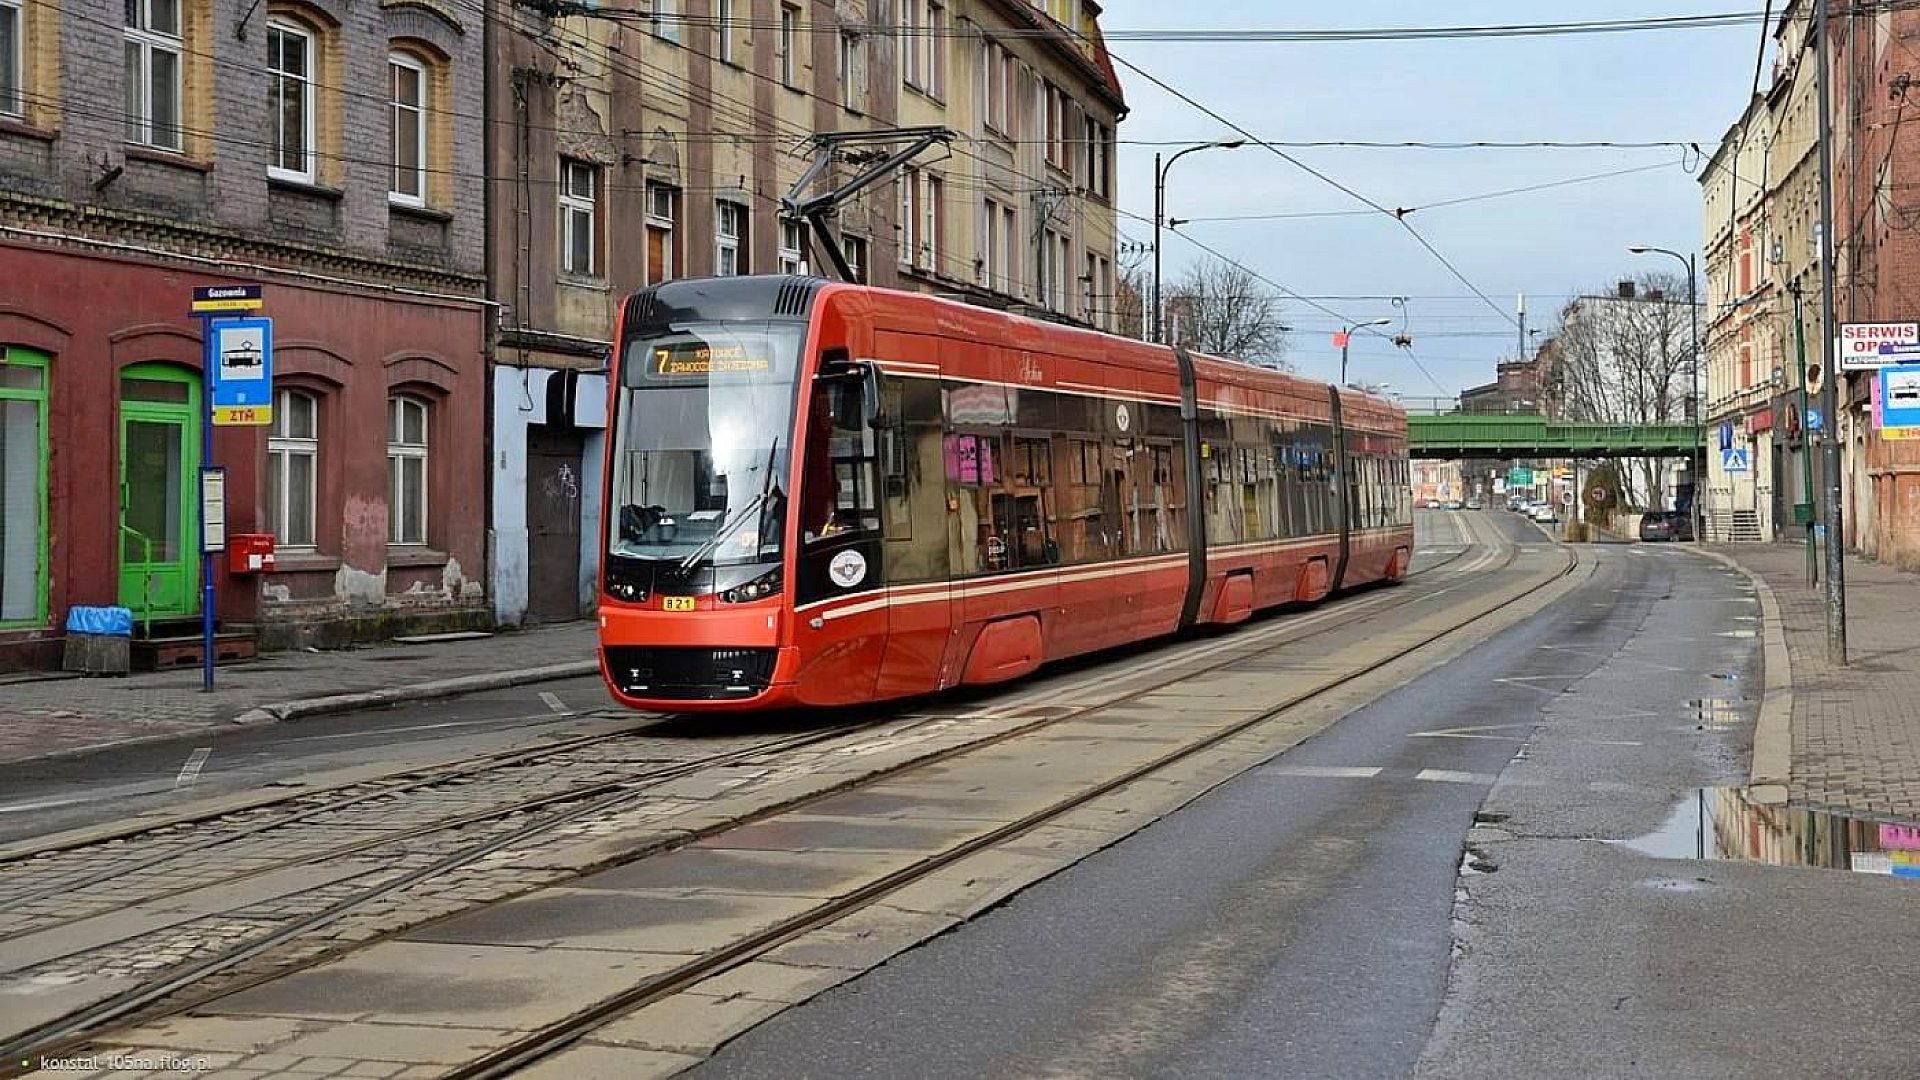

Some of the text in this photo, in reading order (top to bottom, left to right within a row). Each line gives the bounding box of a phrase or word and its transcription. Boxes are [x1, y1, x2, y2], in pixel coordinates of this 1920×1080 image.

[1844, 326, 1914, 338] SERWIS
[656, 349, 669, 374] 7
[667, 599, 691, 609] 821
